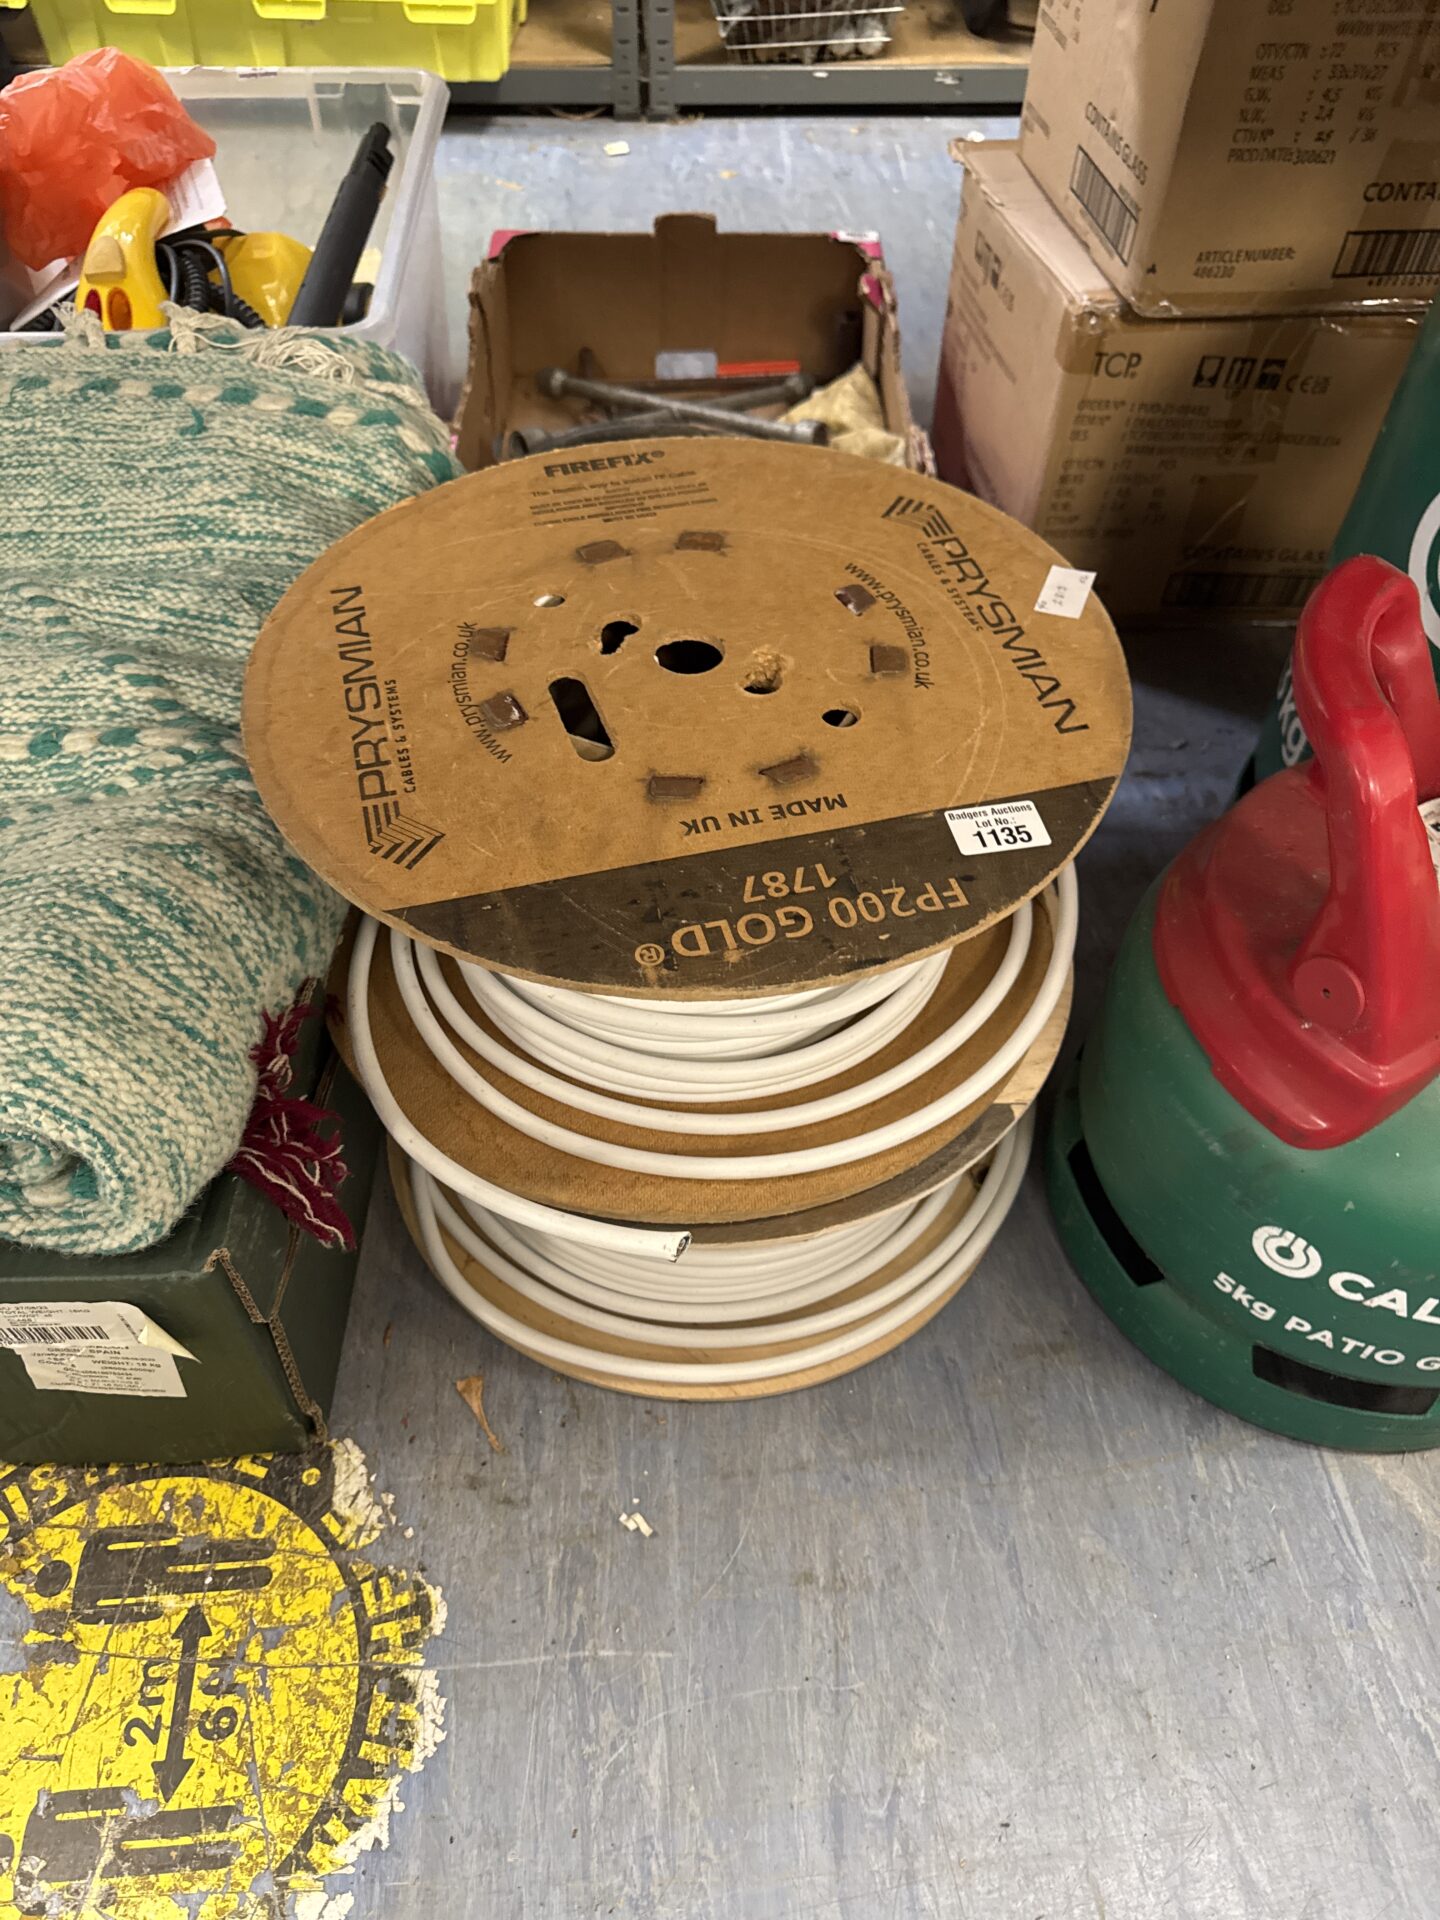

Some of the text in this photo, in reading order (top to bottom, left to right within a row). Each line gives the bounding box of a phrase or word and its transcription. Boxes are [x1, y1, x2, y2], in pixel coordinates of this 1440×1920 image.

[1195, 248, 1244, 264] ARTICLE
[916, 542, 945, 576] CABLES
[946, 588, 984, 632] SYSTEMS
[844, 561, 935, 690] www.prysmian.co.uk
[932, 536, 1090, 735] PRYSMIAN
[330, 584, 397, 802] PRYSMIAN
[446, 621, 513, 764] www.prysmian.co.uk
[384, 679, 417, 794] CABLES & SYSTEMS
[679, 793, 849, 837] MADE IN UK
[948, 803, 1033, 821] Badgers Auctions
[972, 824, 1033, 848] 1135
[975, 819, 993, 829] Lot
[742, 862, 838, 904] 1787
[827, 878, 971, 929] FP200
[1213, 1271, 1278, 1322] 5kg
[1284, 1316, 1406, 1366] PATIO
